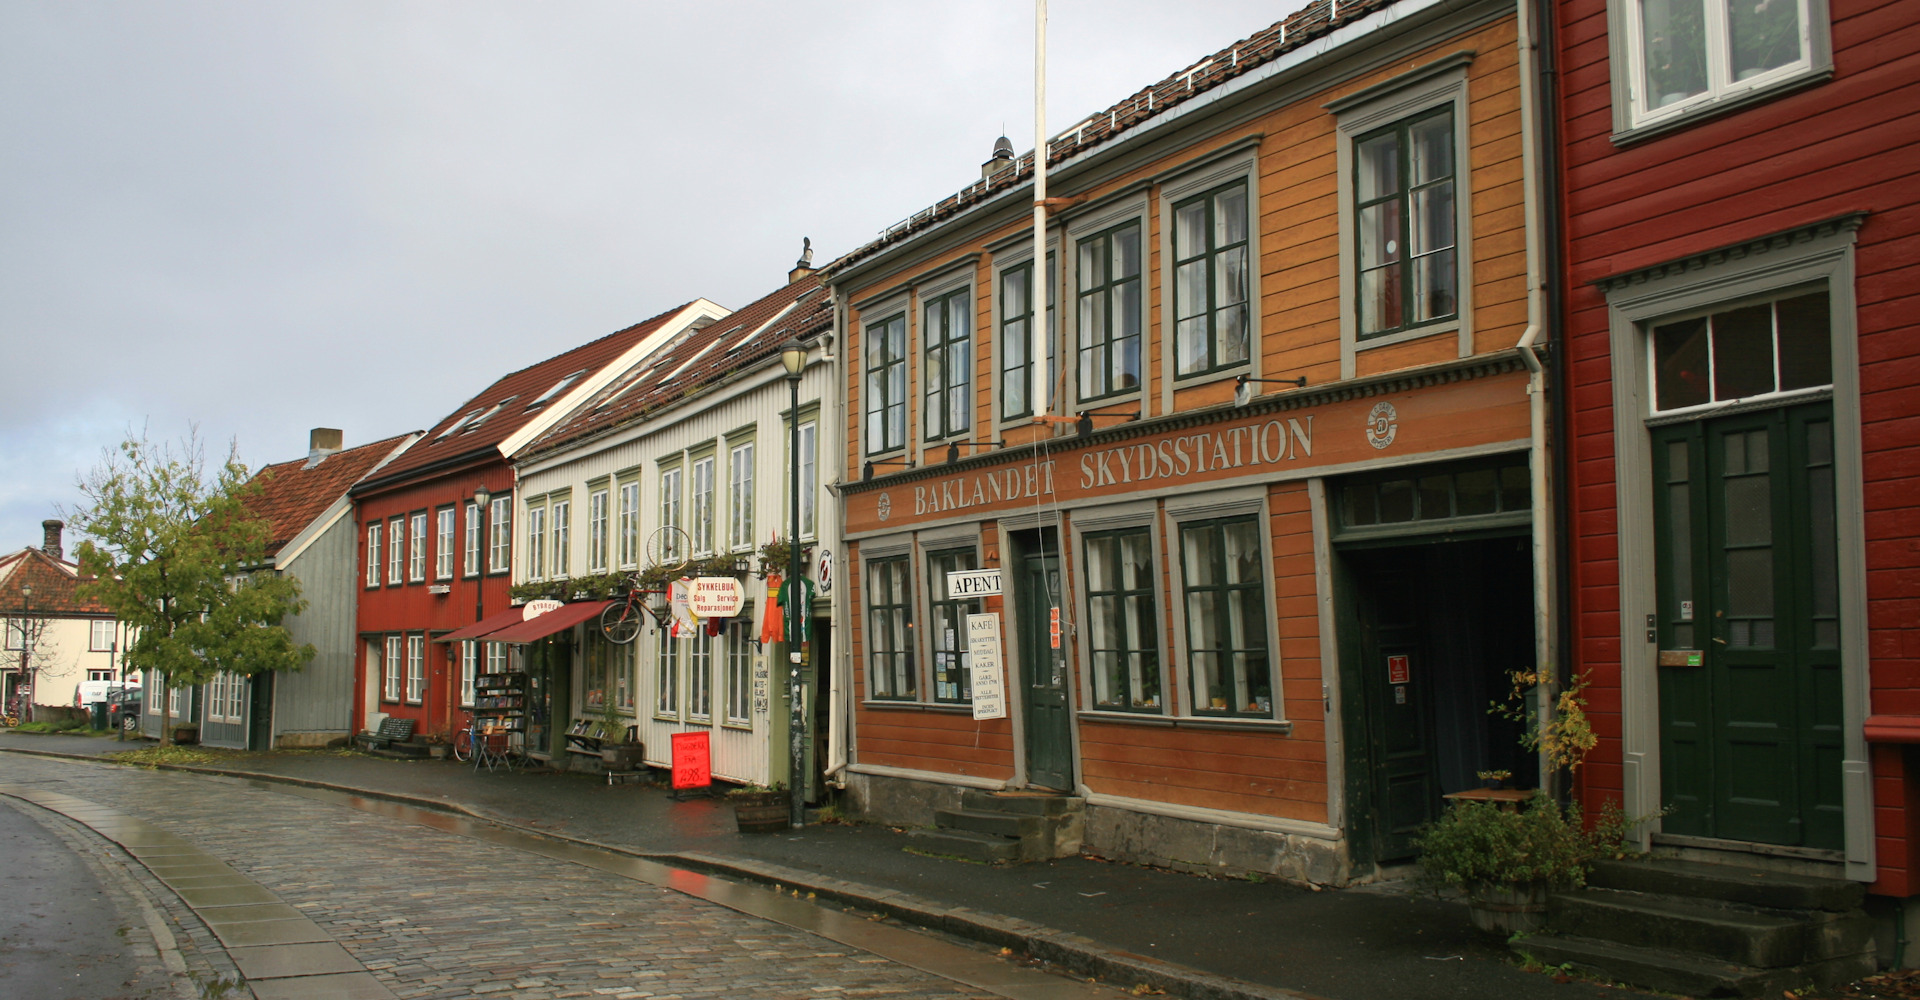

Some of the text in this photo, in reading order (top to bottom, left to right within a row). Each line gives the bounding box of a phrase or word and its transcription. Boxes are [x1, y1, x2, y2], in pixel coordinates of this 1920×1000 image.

[914, 459, 1057, 517] BAKLANDET
[1080, 414, 1314, 490] SKYDSSTATION
[697, 582, 734, 592] SYKKELBUA
[953, 575, 1001, 594] ÅPENT
[693, 594, 706, 604] Salg
[716, 594, 739, 603] Service
[696, 604, 735, 613] Reparasjoner
[970, 618, 993, 631] KAFÉ
[975, 661, 995, 669] KAKER
